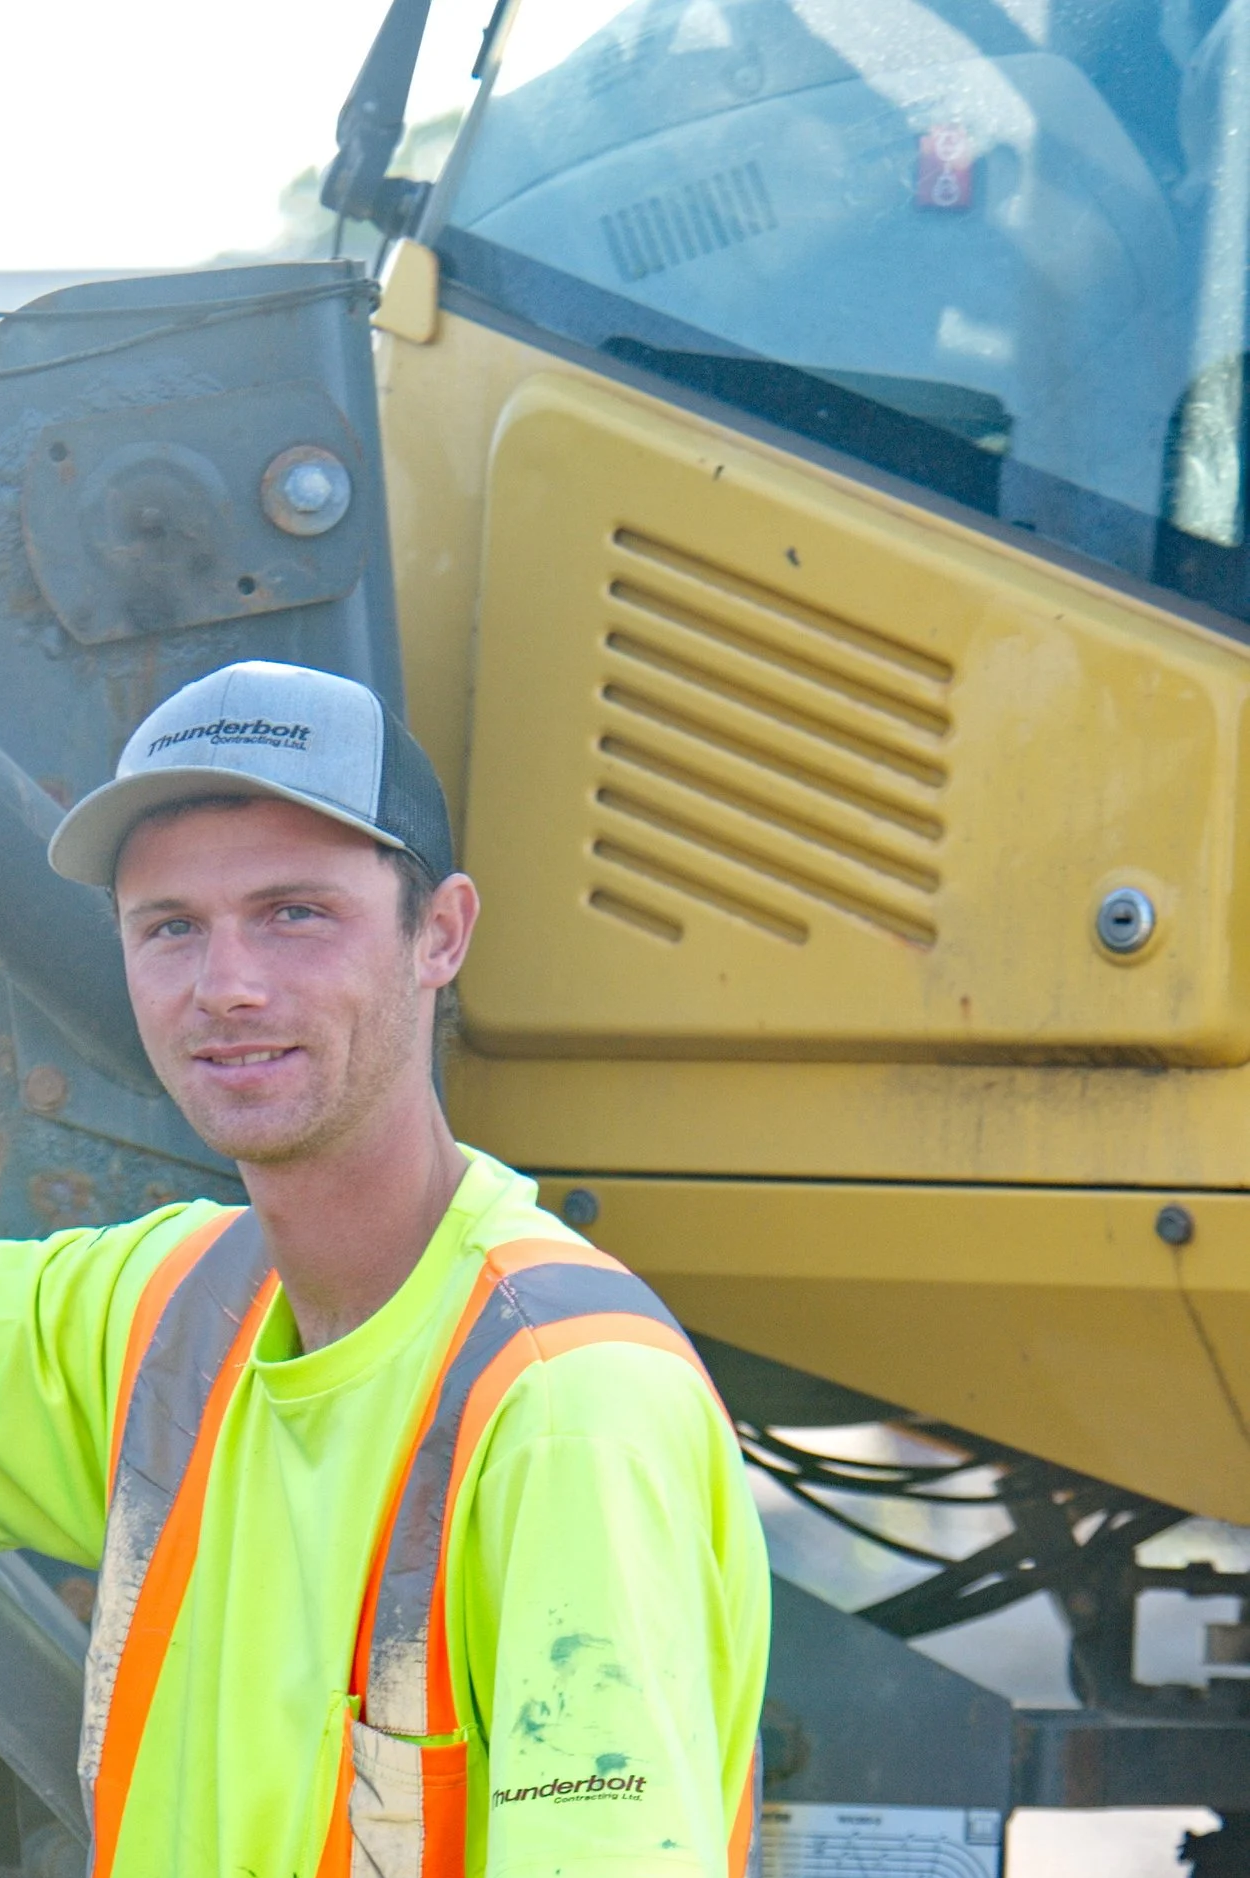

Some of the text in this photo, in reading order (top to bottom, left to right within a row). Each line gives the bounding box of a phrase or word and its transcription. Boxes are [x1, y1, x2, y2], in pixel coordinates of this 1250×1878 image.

[148, 719, 310, 757] Thunderbolt
[210, 733, 281, 748] Contracting
[554, 1792, 643, 1804] Contracting Ltd.
